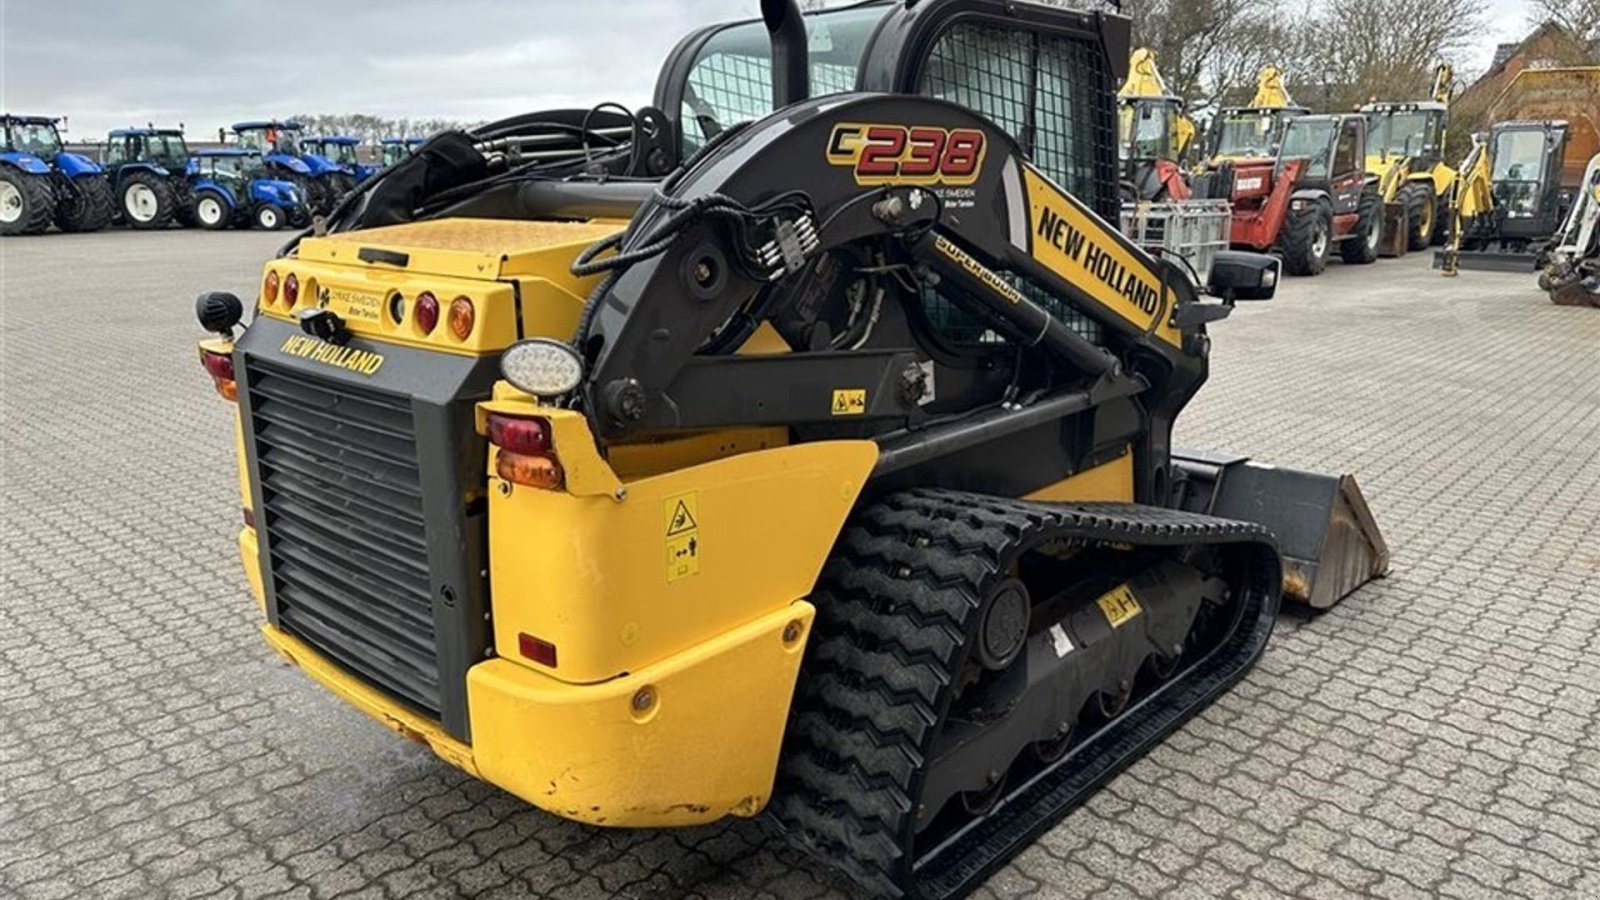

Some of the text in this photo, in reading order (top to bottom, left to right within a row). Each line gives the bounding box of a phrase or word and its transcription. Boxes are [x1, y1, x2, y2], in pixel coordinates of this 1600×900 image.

[827, 123, 986, 185] C238
[936, 238, 981, 276] SUPER
[1037, 205, 1158, 316] NEW HOLLAND
[281, 335, 384, 375] NEW HOLLAND
